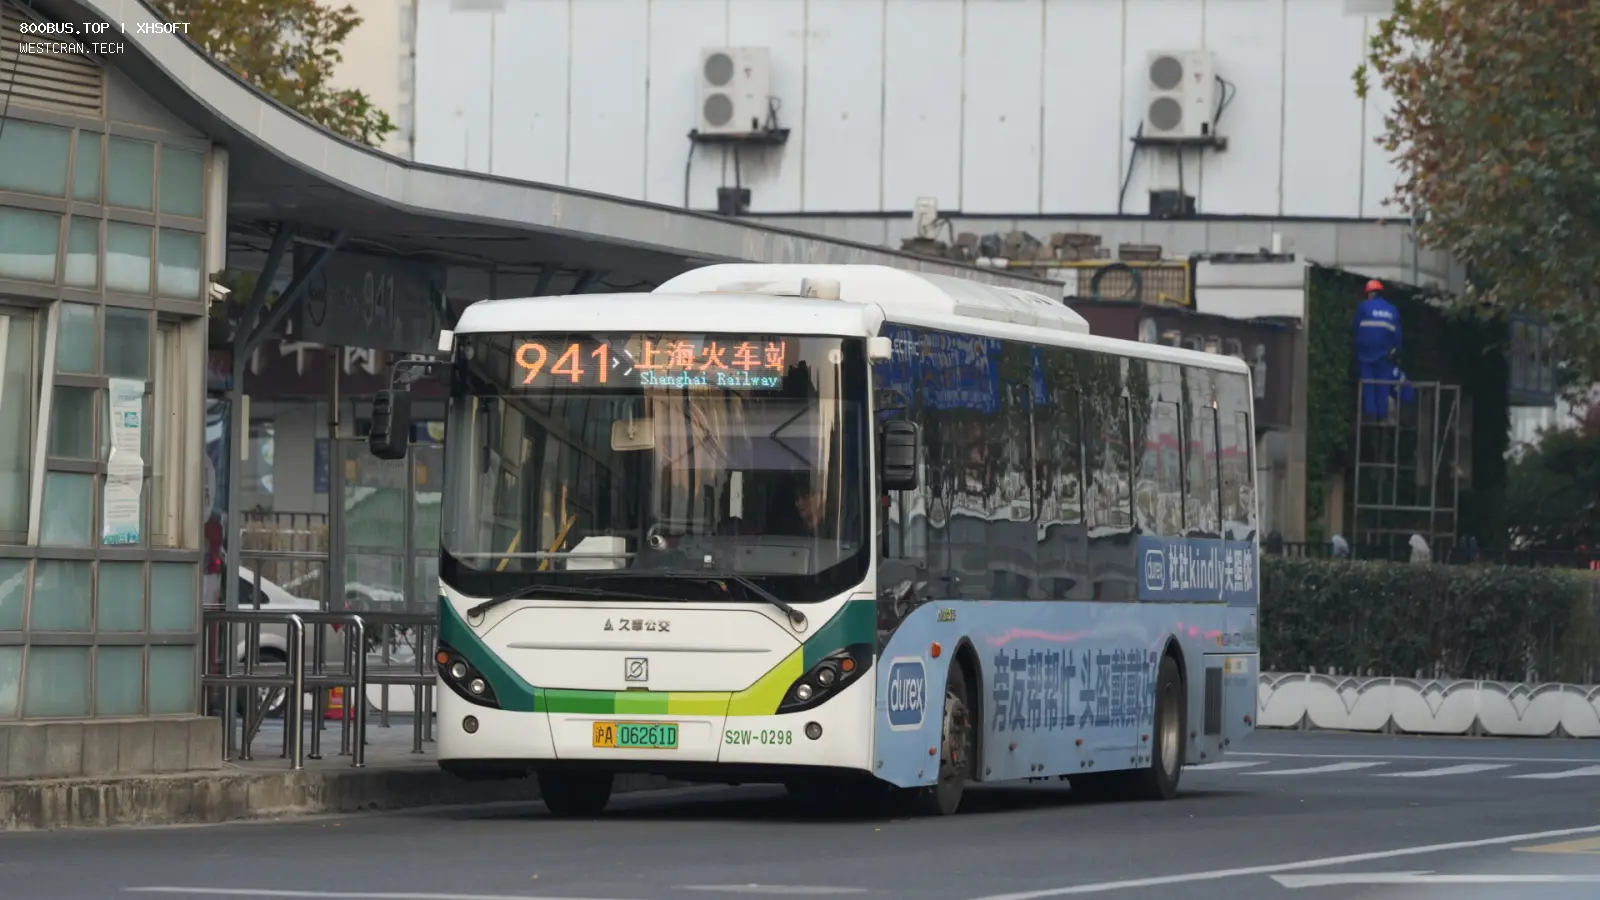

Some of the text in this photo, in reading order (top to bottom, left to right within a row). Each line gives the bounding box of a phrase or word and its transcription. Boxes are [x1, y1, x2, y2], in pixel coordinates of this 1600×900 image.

[515, 343, 609, 384] 941
[640, 371, 778, 387] Shanghai Railway
[890, 668, 923, 714] durex
[725, 729, 793, 745] S2W-0298
